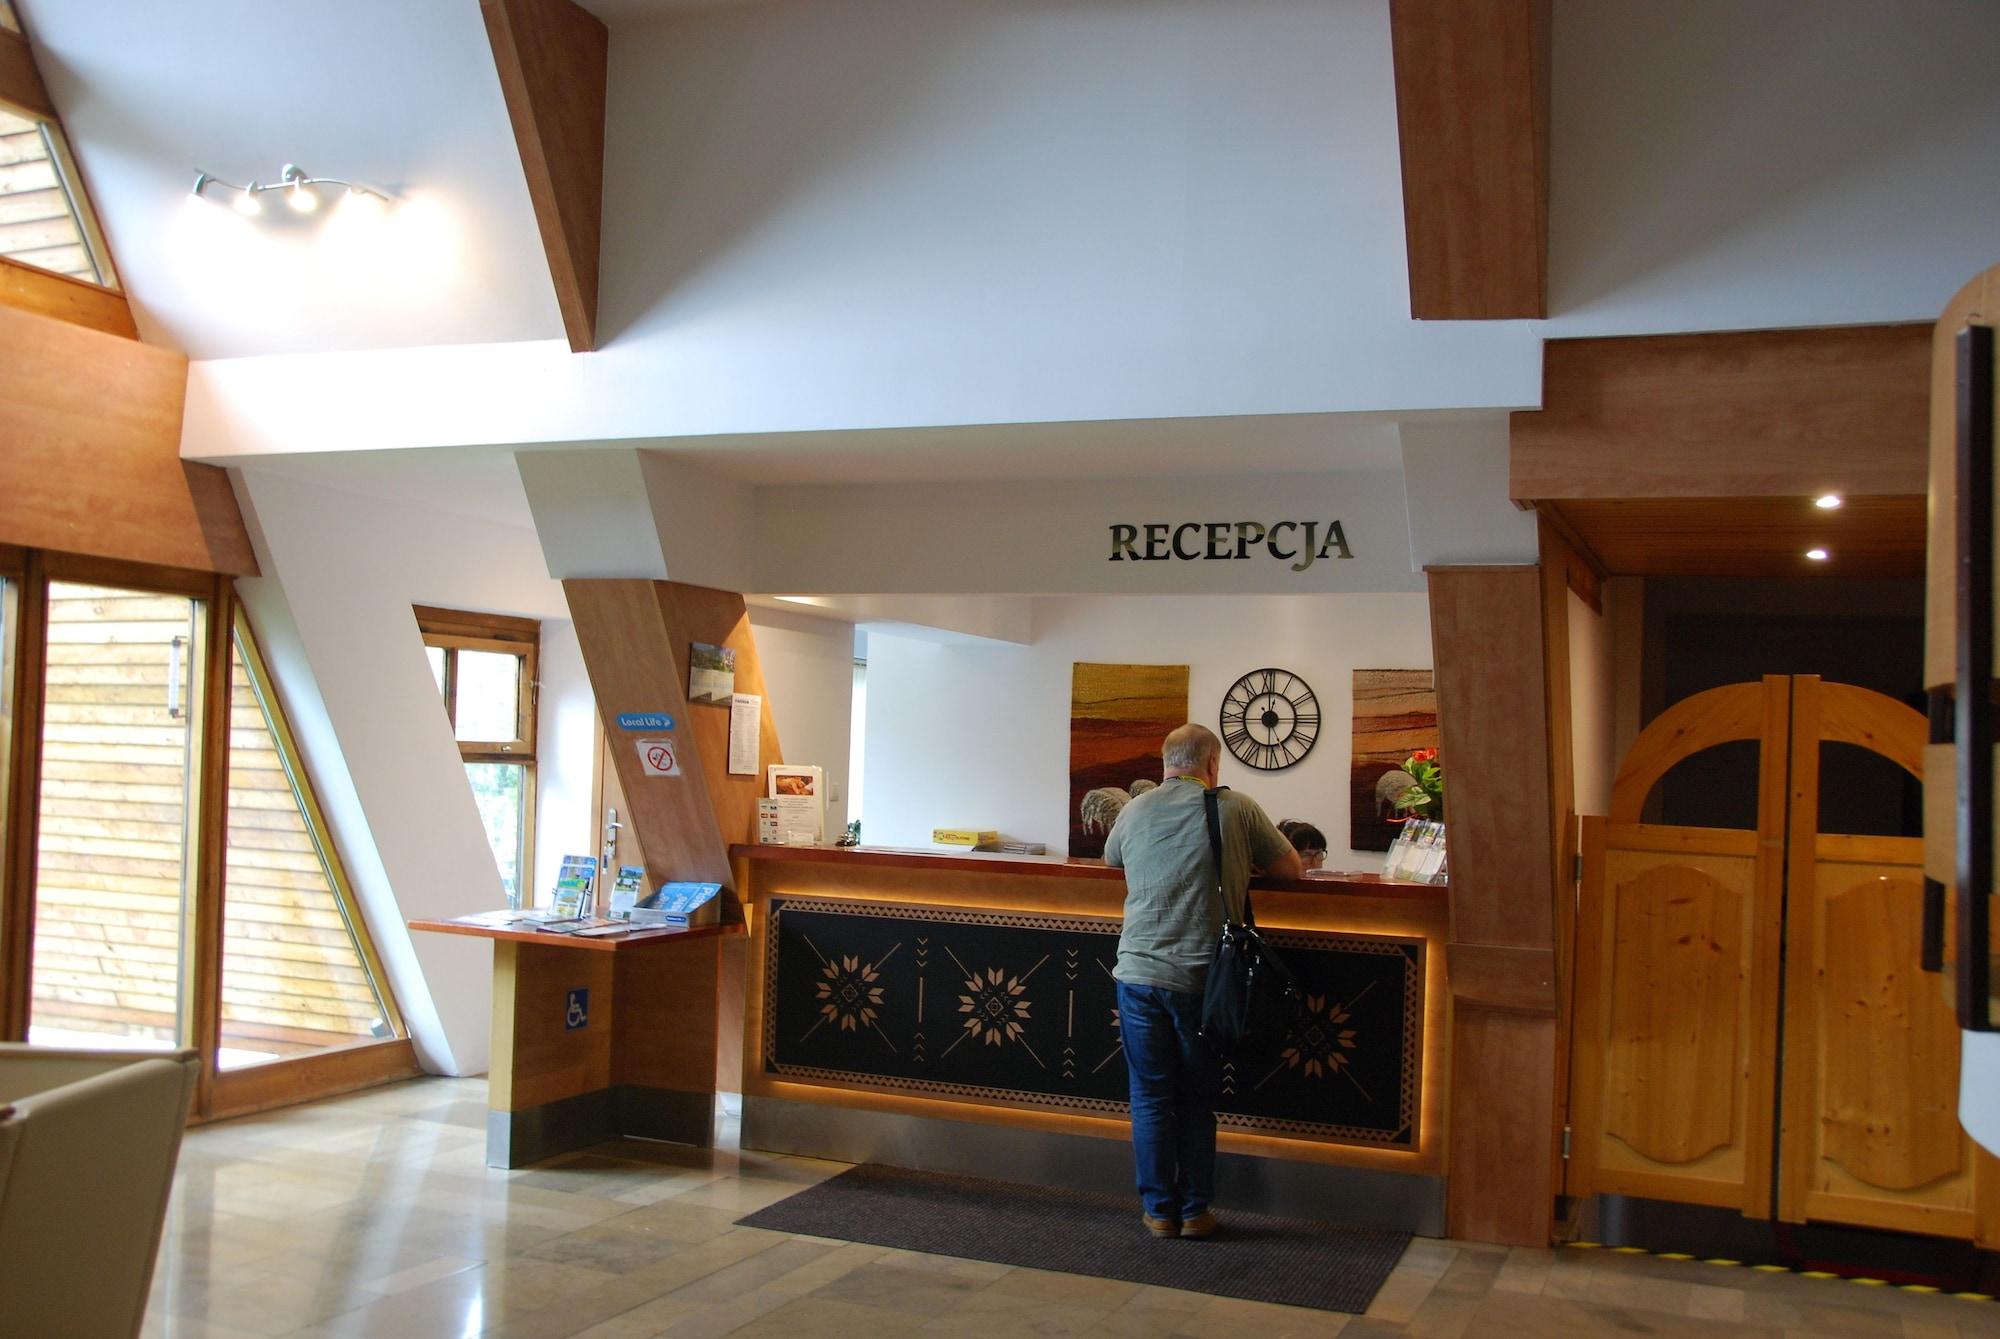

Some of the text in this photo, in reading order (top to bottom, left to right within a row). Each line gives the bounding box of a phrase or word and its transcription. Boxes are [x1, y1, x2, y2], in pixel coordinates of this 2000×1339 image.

[1108, 520, 1354, 571] RECEPCJA
[1260, 671, 1275, 693] XII
[1291, 691, 1314, 707] II
[621, 716, 663, 727] Local Life
[1296, 714, 1318, 724] III
